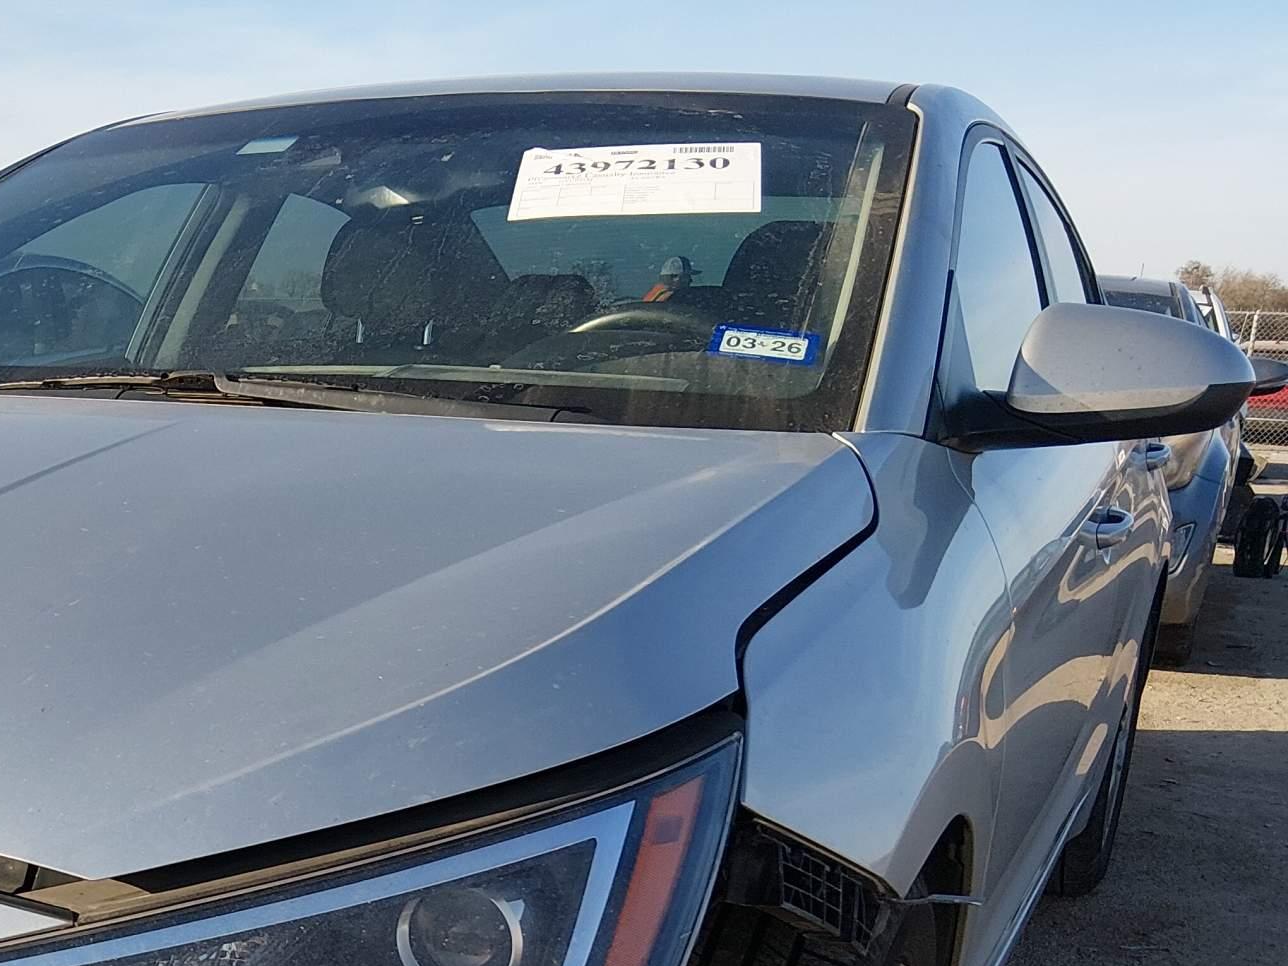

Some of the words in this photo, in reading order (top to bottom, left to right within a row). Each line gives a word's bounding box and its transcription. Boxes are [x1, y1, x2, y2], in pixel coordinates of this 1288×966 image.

[543, 157, 730, 176] 43972130
[726, 335, 757, 350] 03
[770, 340, 802, 354] 26
